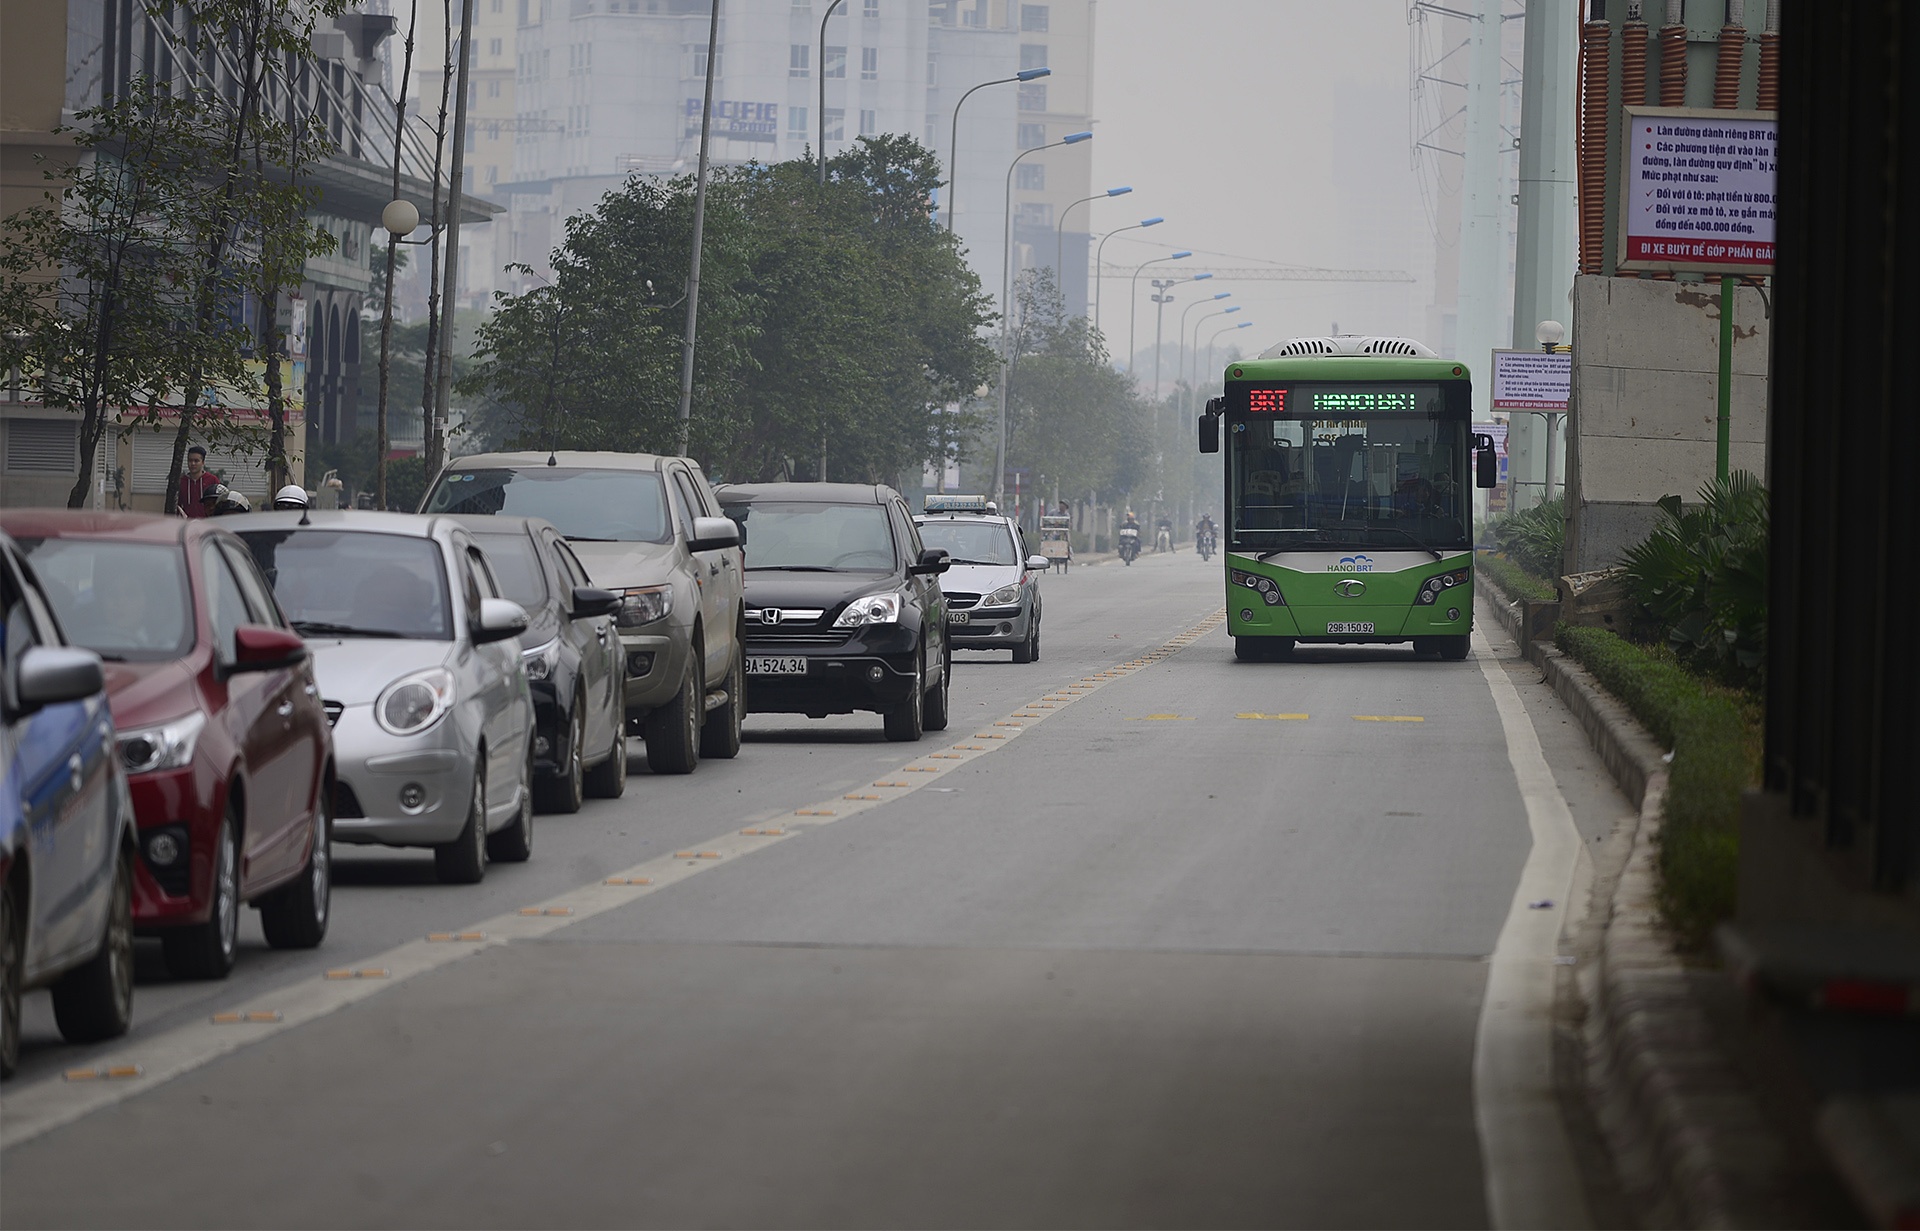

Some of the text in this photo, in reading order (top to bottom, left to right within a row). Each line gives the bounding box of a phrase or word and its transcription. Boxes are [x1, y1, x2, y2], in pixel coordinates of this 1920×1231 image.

[1658, 126, 1672, 135] Làn
[1674, 127, 1700, 138] đường
[1702, 128, 1723, 138] dành
[1725, 129, 1747, 140] riêng
[1749, 130, 1766, 140] BRT
[1657, 142, 1673, 151] Các
[1675, 144, 1707, 154] phương
[1709, 145, 1725, 156] tiện
[1728, 146, 1735, 154] đi
[1738, 145, 1753, 155] vào
[1755, 146, 1768, 156] làn
[1642, 156, 1671, 167] đường,
[1673, 157, 1686, 167] làn
[1689, 158, 1715, 169] đường
[1717, 161, 1732, 170] quy
[1759, 161, 1767, 173] bị
[1642, 170, 1718, 183] Mức phạt như sau:
[1657, 188, 1670, 198] Đối
[1672, 190, 1685, 199] với
[1687, 190, 1692, 199] ô
[1694, 191, 1704, 200] tô:
[1706, 192, 1725, 203] phạt
[1744, 192, 1753, 202] từ
[1656, 203, 1670, 213] Đối
[1672, 205, 1685, 214] với
[1688, 206, 1697, 215] xe
[1700, 206, 1713, 216] mô
[1716, 207, 1726, 217] tô,
[1729, 208, 1739, 217] xe
[1678, 219, 1694, 230] đến
[1695, 221, 1729, 232] 400.000
[1641, 243, 1650, 253] ĐI
[1653, 243, 1664, 254] XE
[1668, 242, 1690, 255] BUÝT
[1692, 241, 1706, 256] ĐỂ
[1707, 244, 1725, 257] GÓP
[1250, 390, 1287, 411] BRT
[1313, 394, 1374, 410] HANOI
[1329, 623, 1372, 632] 29B-150.92
